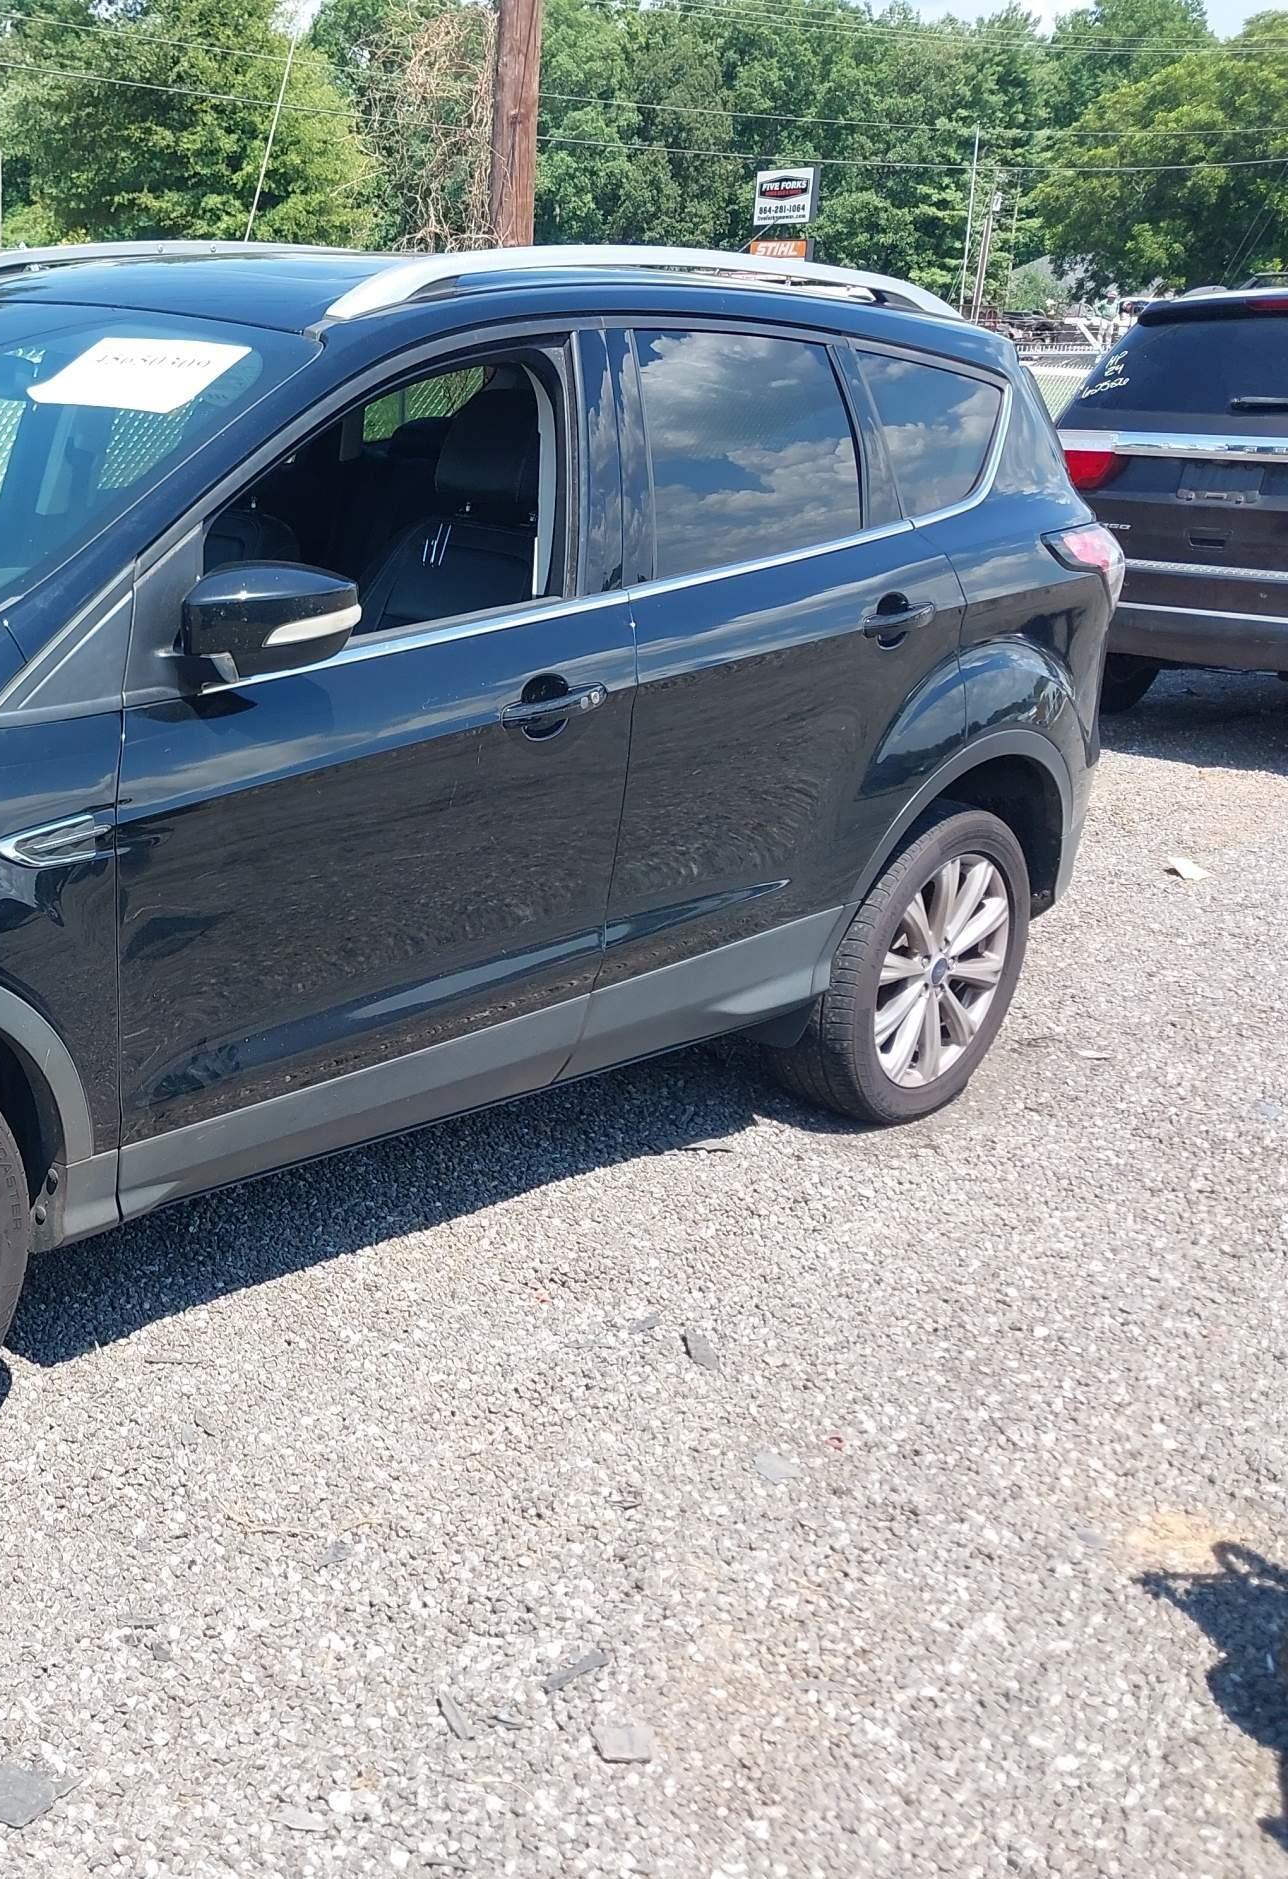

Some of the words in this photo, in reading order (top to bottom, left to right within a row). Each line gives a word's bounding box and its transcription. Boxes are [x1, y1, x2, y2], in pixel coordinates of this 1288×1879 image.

[762, 182, 780, 191] FIVE
[781, 181, 807, 189] FORKS
[755, 241, 798, 256] STIHL
